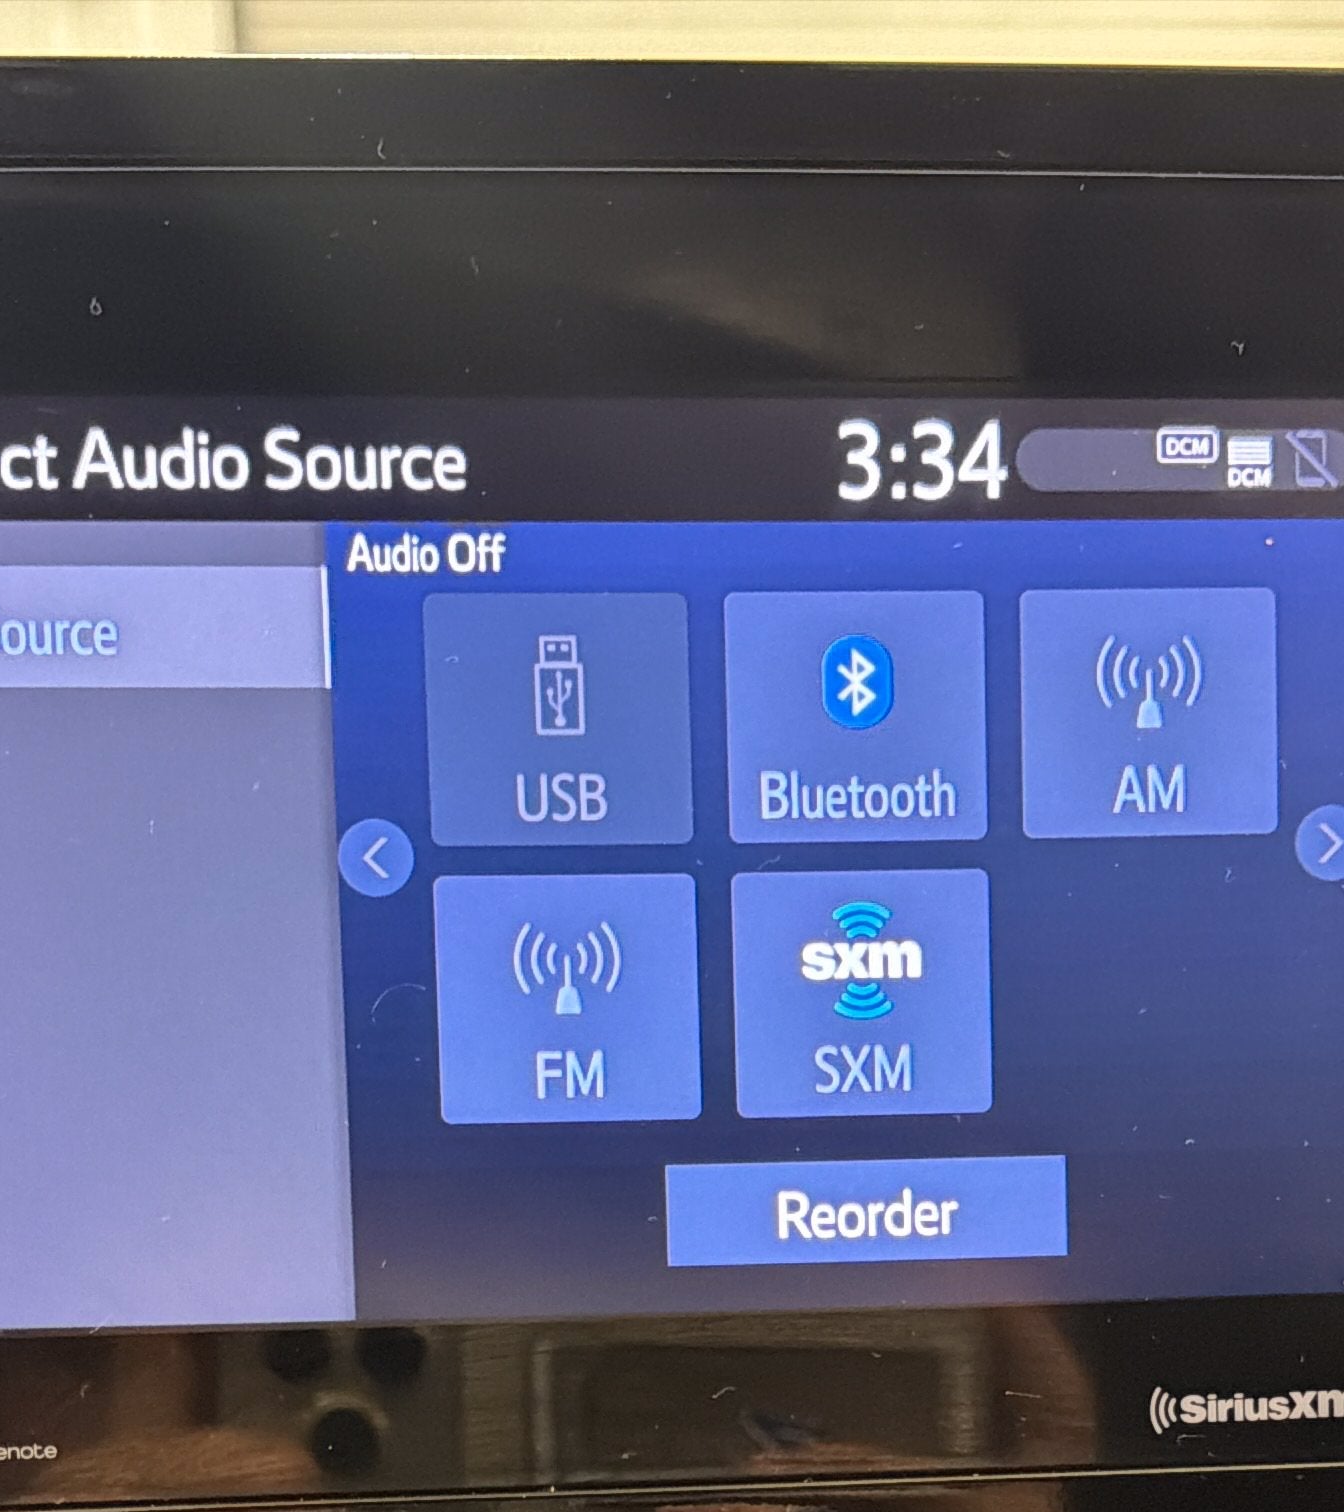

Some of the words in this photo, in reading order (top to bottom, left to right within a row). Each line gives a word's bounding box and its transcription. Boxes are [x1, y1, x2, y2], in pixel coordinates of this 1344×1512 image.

[72, 426, 250, 491] Audio
[264, 426, 467, 492] Source
[838, 417, 1009, 501] 3:34
[1165, 436, 1209, 458] DCM
[1227, 466, 1273, 489] DCM
[346, 532, 440, 573] Audio
[447, 532, 506, 573] Off
[516, 772, 608, 822] USB
[760, 768, 955, 820] Bluetooth
[1112, 764, 1184, 814] AM
[536, 1049, 604, 1100] FM
[814, 1044, 911, 1094] SXM
[777, 1187, 959, 1240] Reorder
